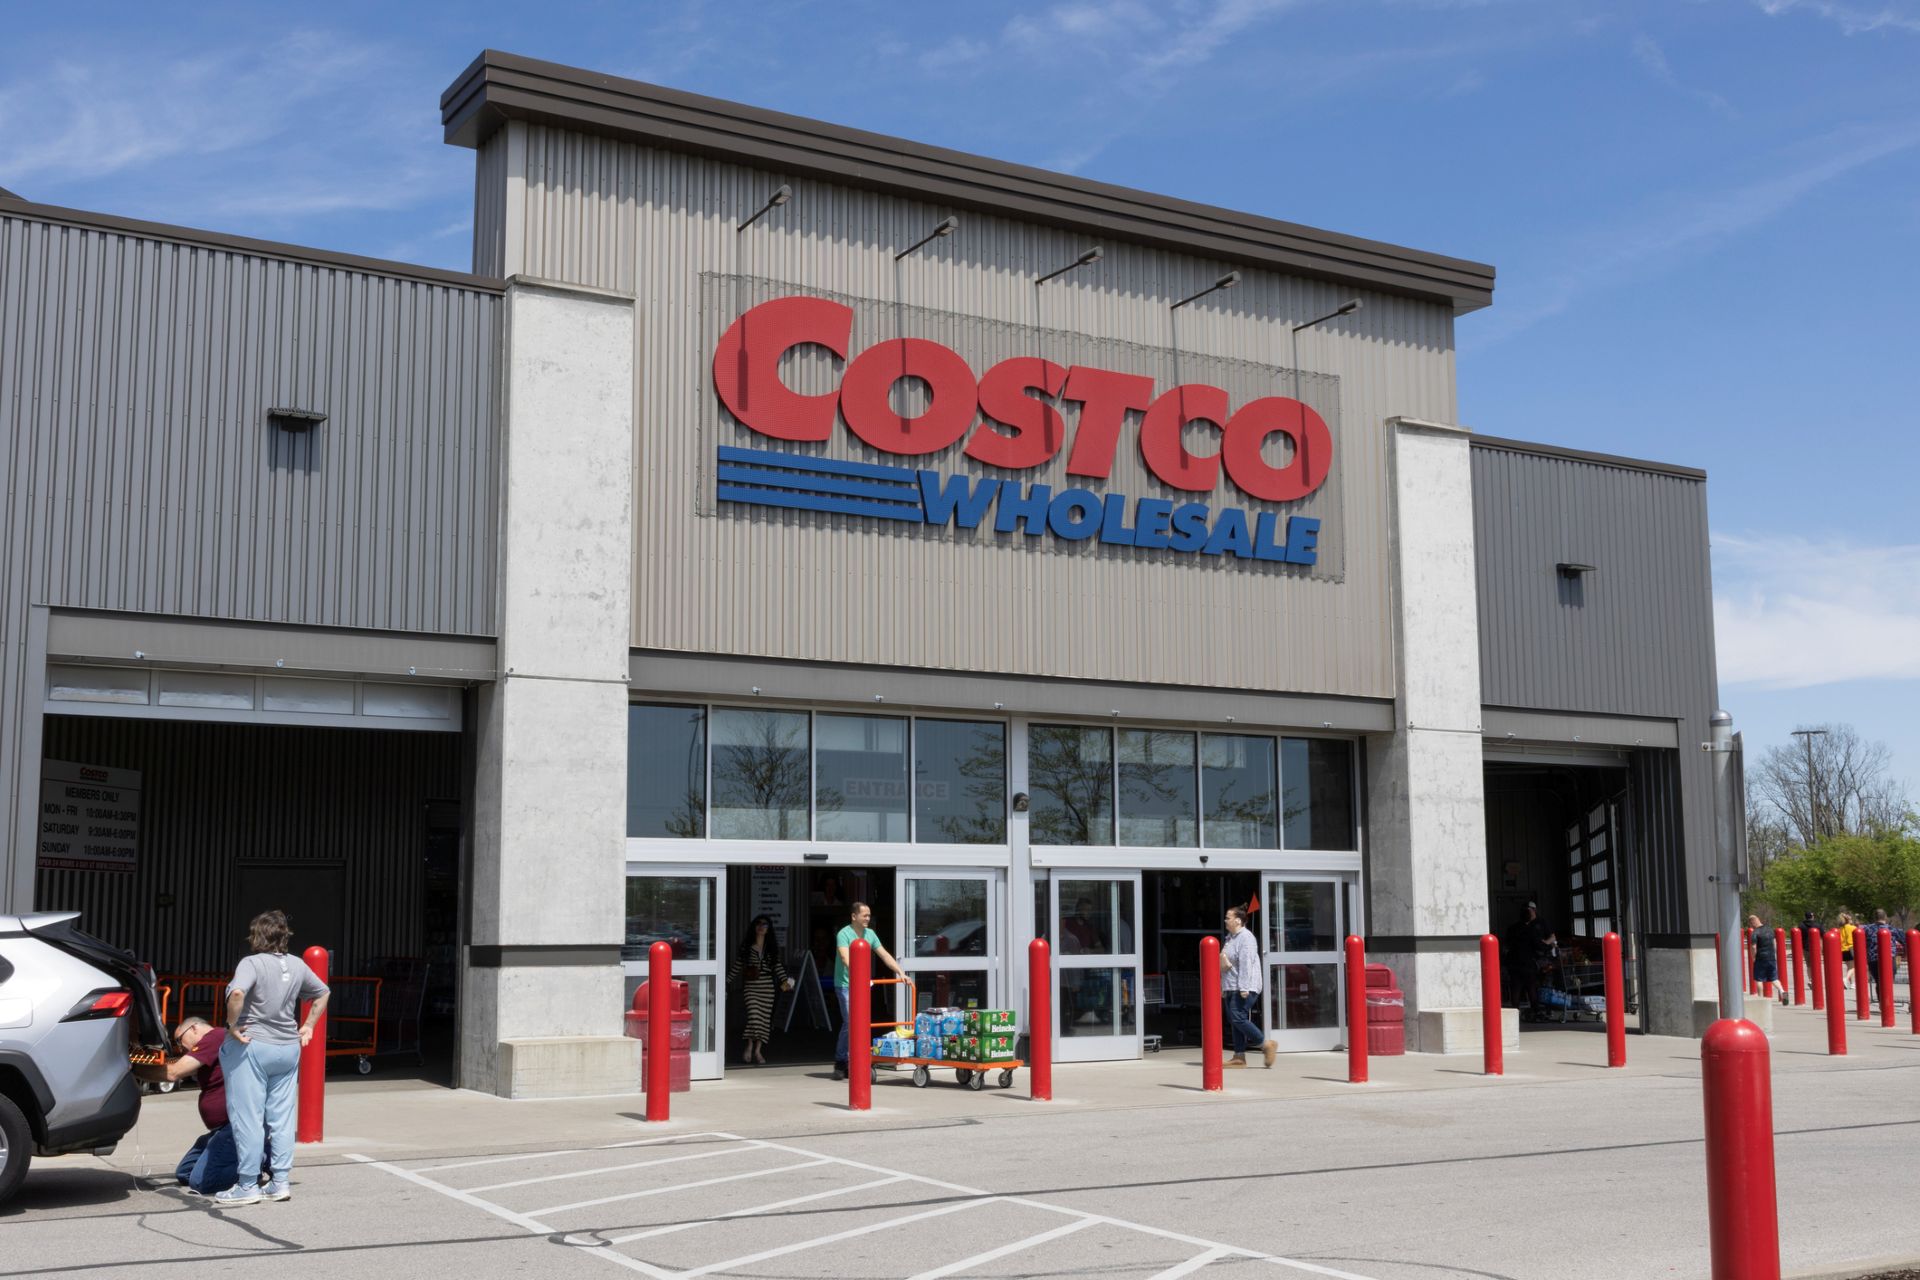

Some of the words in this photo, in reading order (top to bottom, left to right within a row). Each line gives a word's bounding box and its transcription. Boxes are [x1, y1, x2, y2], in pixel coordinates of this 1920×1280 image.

[712, 295, 1333, 502] COSTCO
[917, 469, 1321, 566] WHOLESALE
[80, 766, 109, 778] COSTCO
[65, 786, 101, 801] MEMBERS
[102, 790, 120, 803] ONLY
[44, 803, 61, 815] MON
[66, 804, 78, 817] FRI
[42, 822, 80, 836] SATURDAY
[41, 841, 71, 854] SUNDAY
